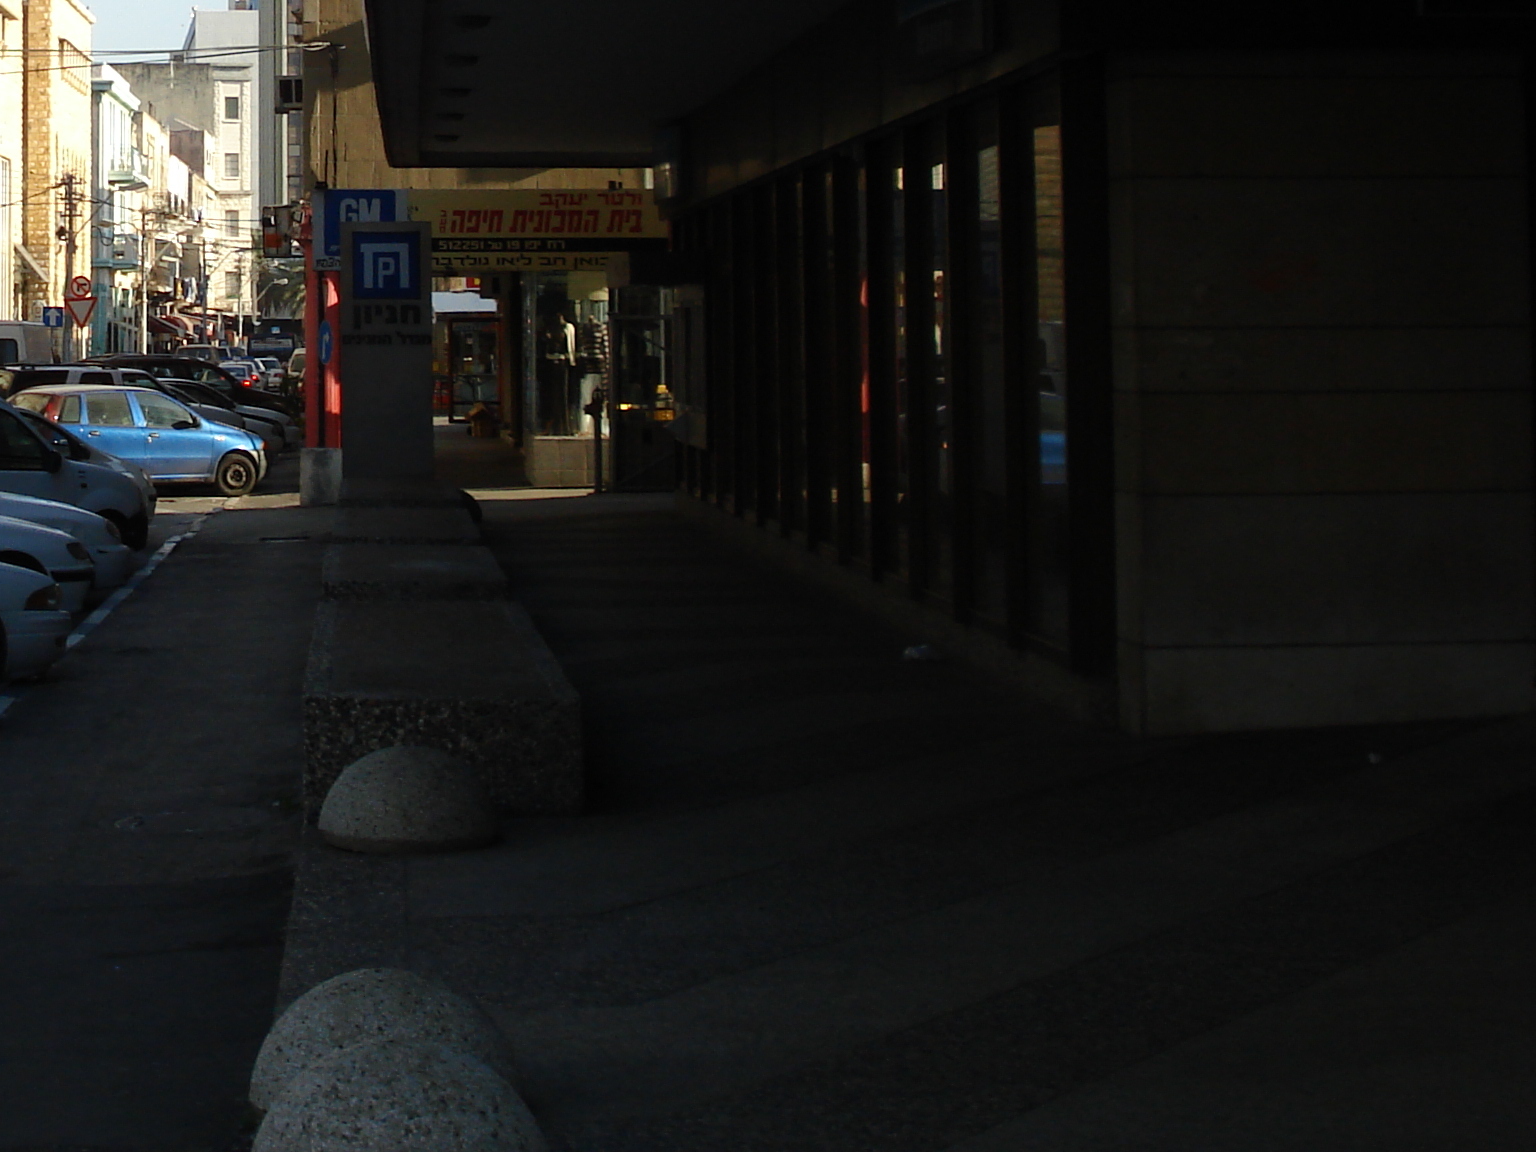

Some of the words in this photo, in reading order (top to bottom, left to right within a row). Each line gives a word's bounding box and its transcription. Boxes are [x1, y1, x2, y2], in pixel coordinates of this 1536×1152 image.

[339, 197, 381, 222] GM
[539, 193, 588, 209] יעקב
[450, 209, 504, 233] חיפה
[509, 209, 600, 233] המכונית
[606, 209, 642, 233] בית
[432, 253, 490, 267] גולדבר
[496, 253, 533, 266] ליאו
[353, 305, 421, 330] חניון
